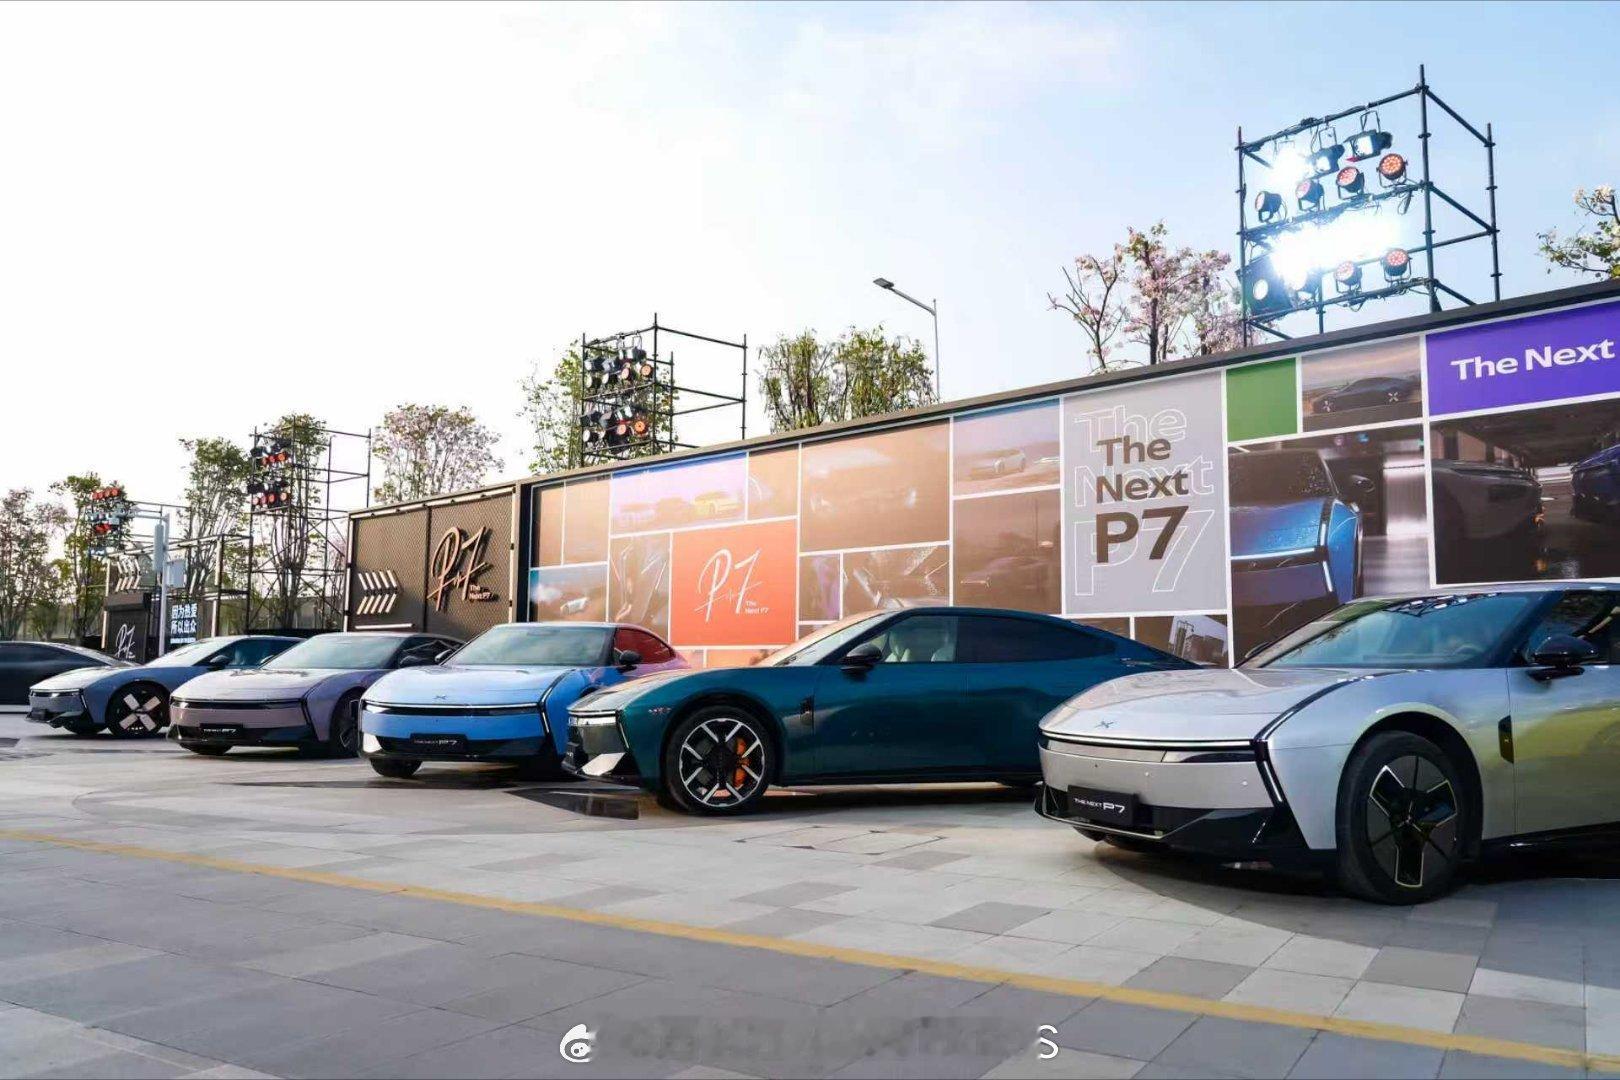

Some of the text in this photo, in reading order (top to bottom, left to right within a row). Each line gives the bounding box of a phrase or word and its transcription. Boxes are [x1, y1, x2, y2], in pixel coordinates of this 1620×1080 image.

[1450, 338, 1616, 381] The Next
[1096, 435, 1171, 466] The
[1096, 470, 1189, 503] Next
[1095, 505, 1189, 563] P7
[1102, 801, 1126, 813] P7
